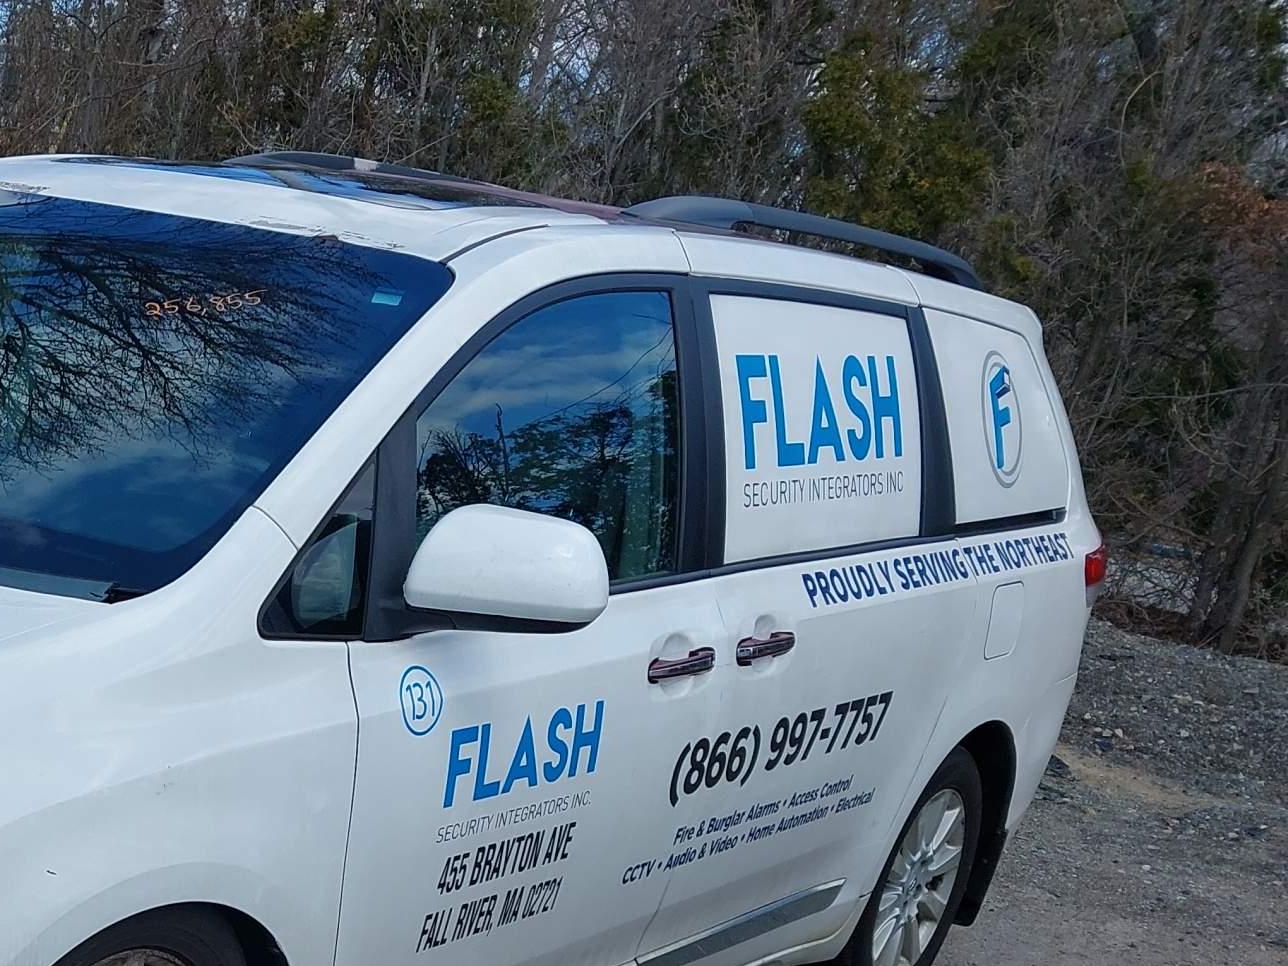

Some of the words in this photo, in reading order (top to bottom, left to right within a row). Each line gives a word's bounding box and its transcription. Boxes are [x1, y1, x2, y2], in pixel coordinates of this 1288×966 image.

[144, 289, 267, 317] 256,855
[736, 354, 904, 470] FLASH
[742, 478, 806, 508] SECURITY
[808, 472, 885, 504] INTEGRATORS
[886, 471, 905, 494] INC
[801, 559, 894, 609] PROUDLY
[893, 549, 969, 592] SERVING
[964, 544, 999, 577] THE
[995, 532, 1076, 573] NORTHEAST
[405, 680, 437, 721] 131
[443, 700, 605, 808] FLASH
[669, 724, 761, 808] (866)
[764, 691, 894, 772] 997-7757
[435, 814, 496, 844] SECURITY
[494, 796, 570, 829] INTEGRATORS
[570, 790, 592, 809] INC.
[622, 860, 657, 885] CCTV
[663, 847, 697, 873] Audio
[698, 842, 708, 860] &
[709, 836, 739, 857] Video
[746, 823, 776, 843] Home
[776, 805, 829, 835] Automation
[835, 788, 875, 814] Electrical
[673, 827, 695, 846] Fire
[696, 819, 706, 838] &
[707, 809, 746, 836] Burglar
[745, 799, 780, 824] Alarms
[788, 788, 819, 809] Access
[819, 774, 854, 798] Control
[437, 852, 471, 896] 455
[468, 829, 546, 888] BRAYTON
[541, 821, 577, 867] AVE
[415, 907, 454, 954] FALL
[451, 894, 499, 937] RIVER,
[496, 886, 526, 928] MA
[521, 876, 564, 920] 02721
